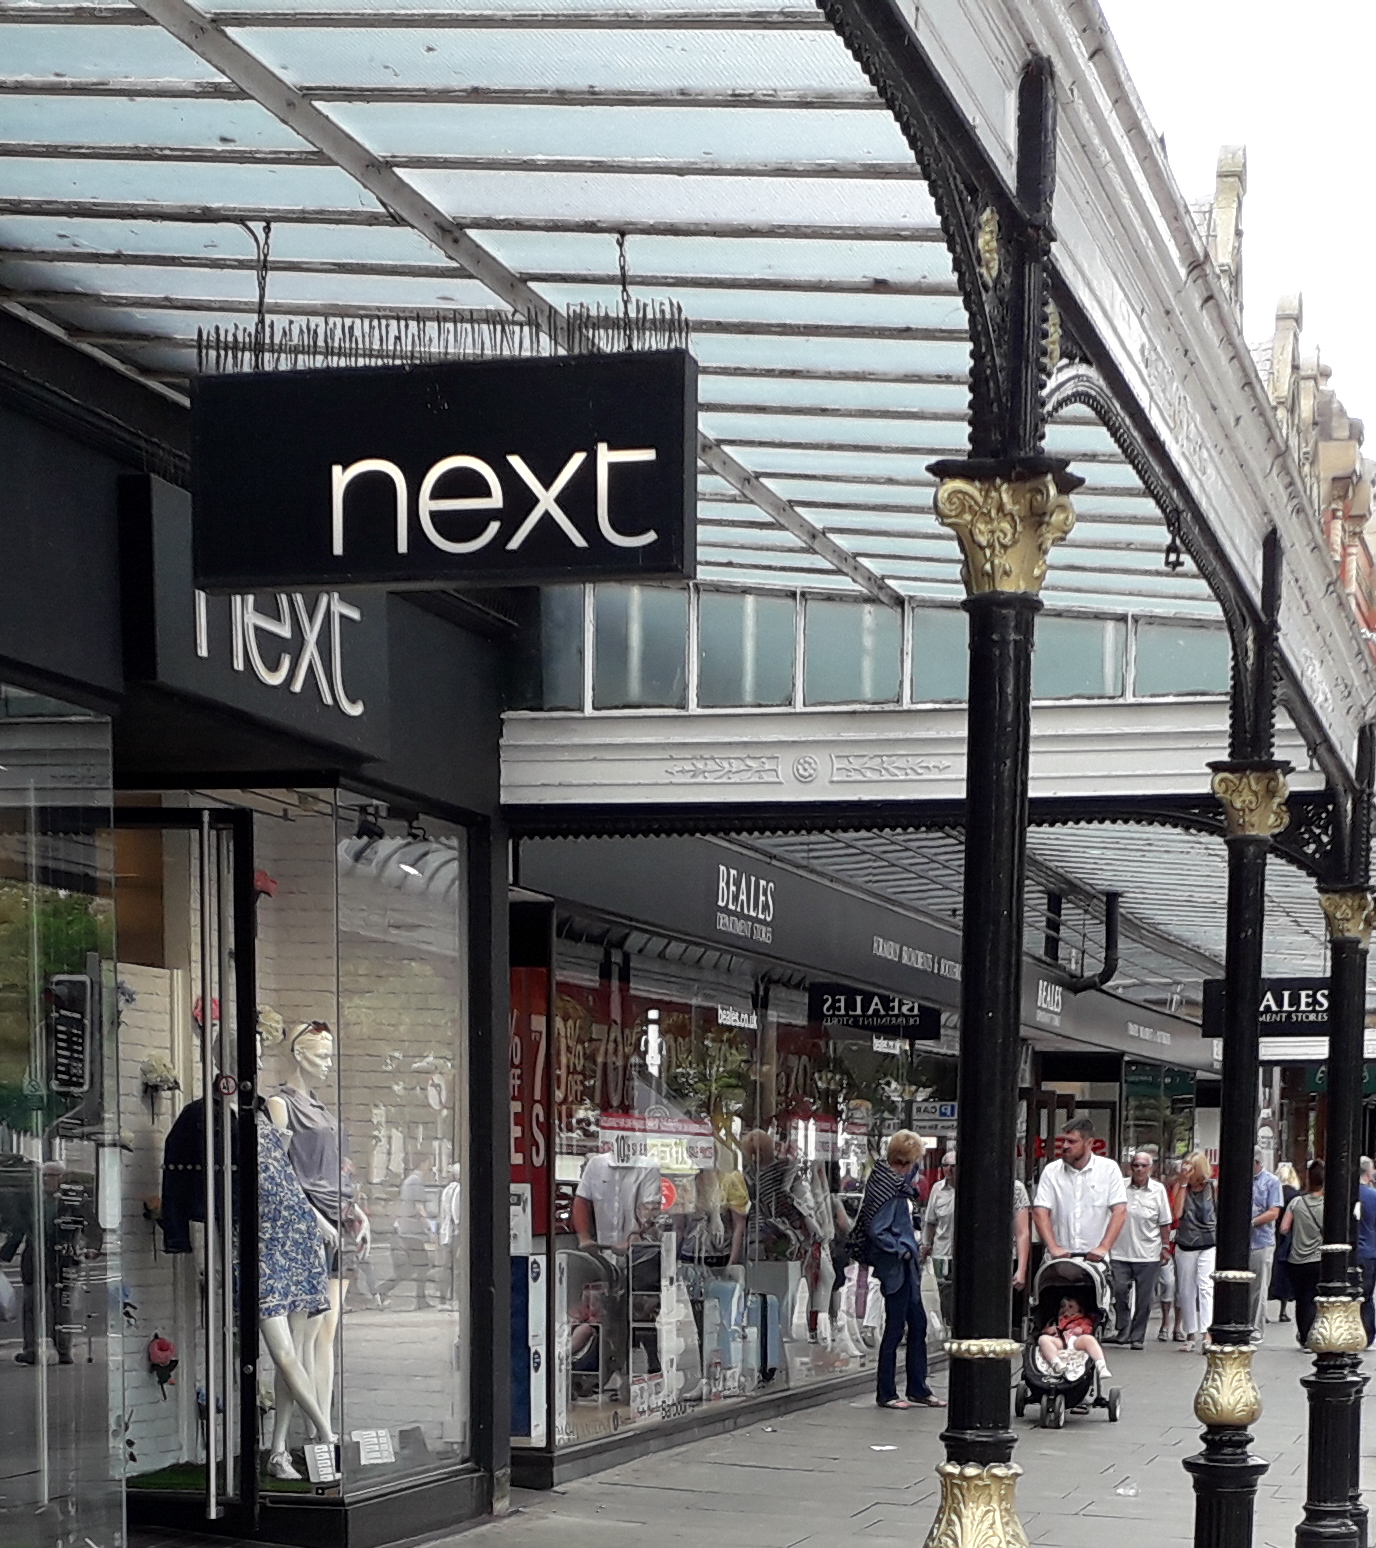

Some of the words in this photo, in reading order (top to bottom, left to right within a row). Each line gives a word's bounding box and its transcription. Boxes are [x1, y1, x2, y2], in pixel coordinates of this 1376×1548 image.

[331, 442, 658, 556] next
[195, 589, 365, 717] next
[717, 863, 775, 922] BEALES
[1259, 990, 1330, 1012] ALES
[1291, 1013, 1329, 1023] STORES
